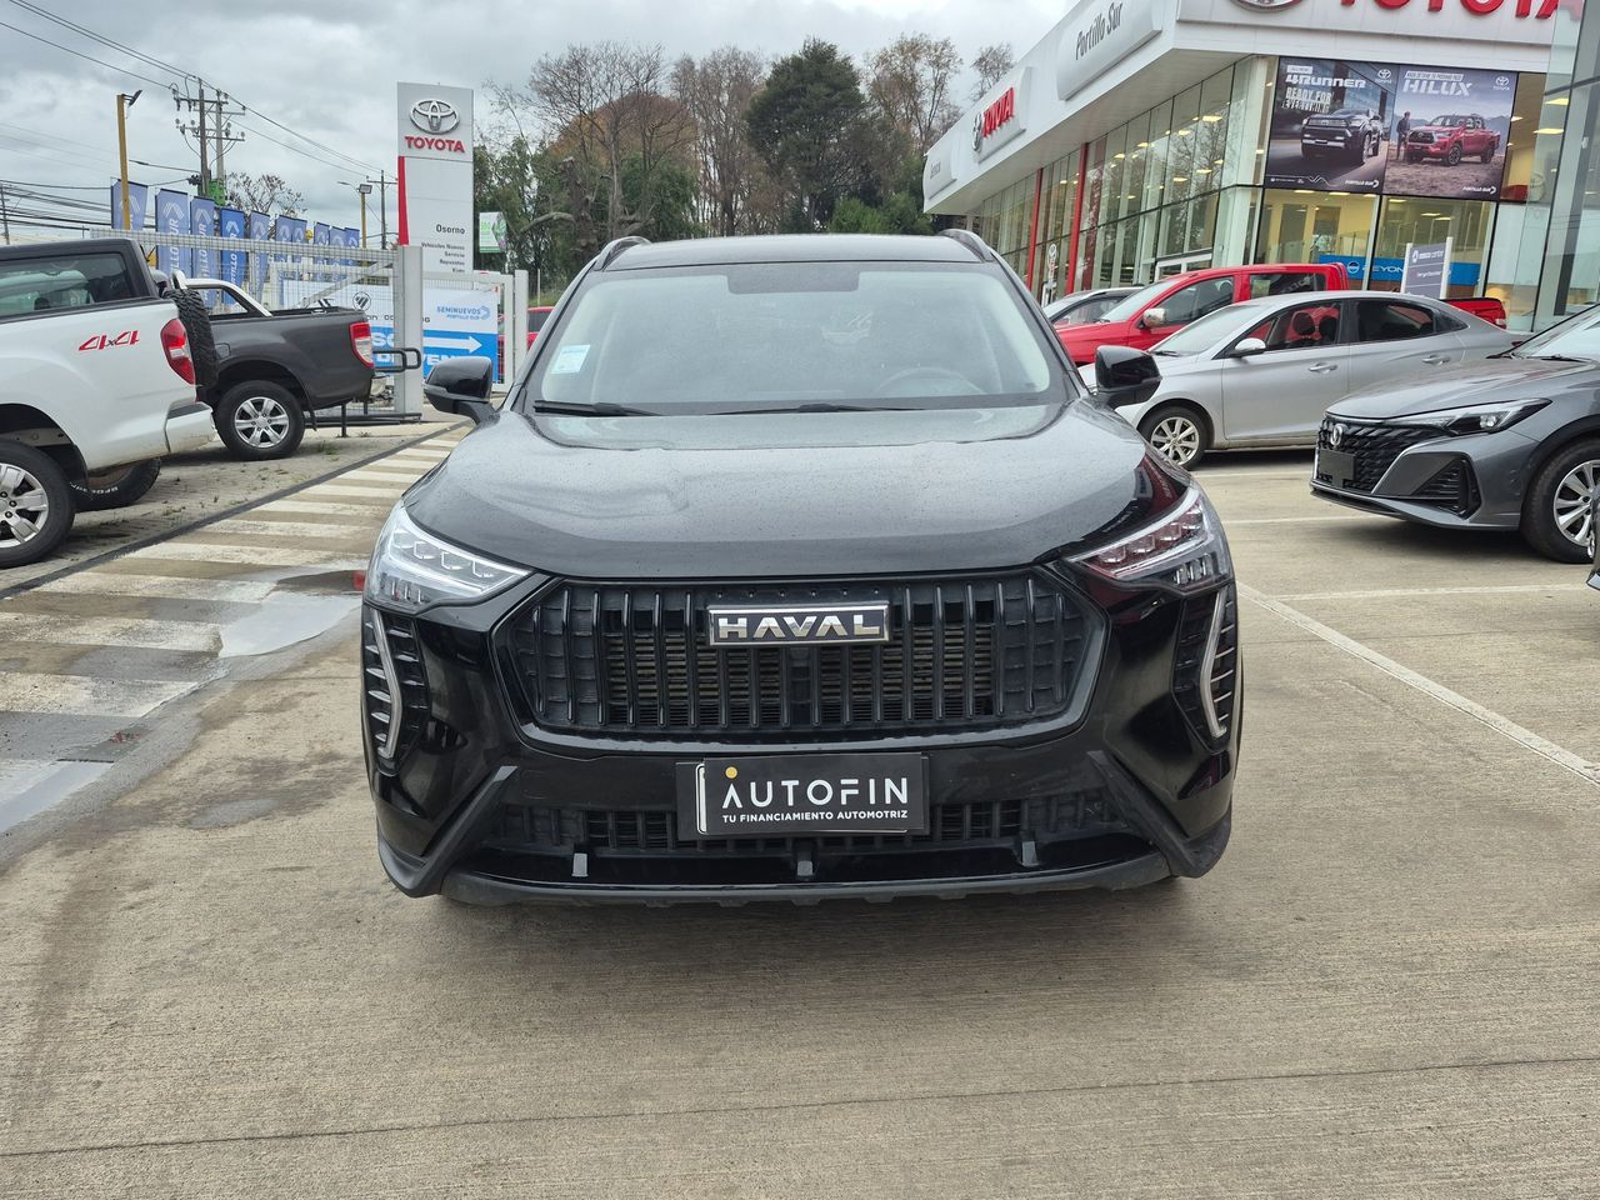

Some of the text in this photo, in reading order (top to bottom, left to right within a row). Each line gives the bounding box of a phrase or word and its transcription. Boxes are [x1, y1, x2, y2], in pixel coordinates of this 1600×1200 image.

[1075, 2, 1123, 61] Portillo Sur
[1403, 79, 1472, 96] HILUX
[404, 136, 466, 154] TOYOTA
[435, 224, 466, 235] Osorno
[437, 305, 481, 315] SEMINUEVOS
[78, 329, 140, 351] 4x4
[718, 614, 881, 639] HAVAL
[722, 775, 908, 809] AUTOFIN
[722, 810, 908, 823] TU FINANCIAMIENTO AUTOMOTRIZ
